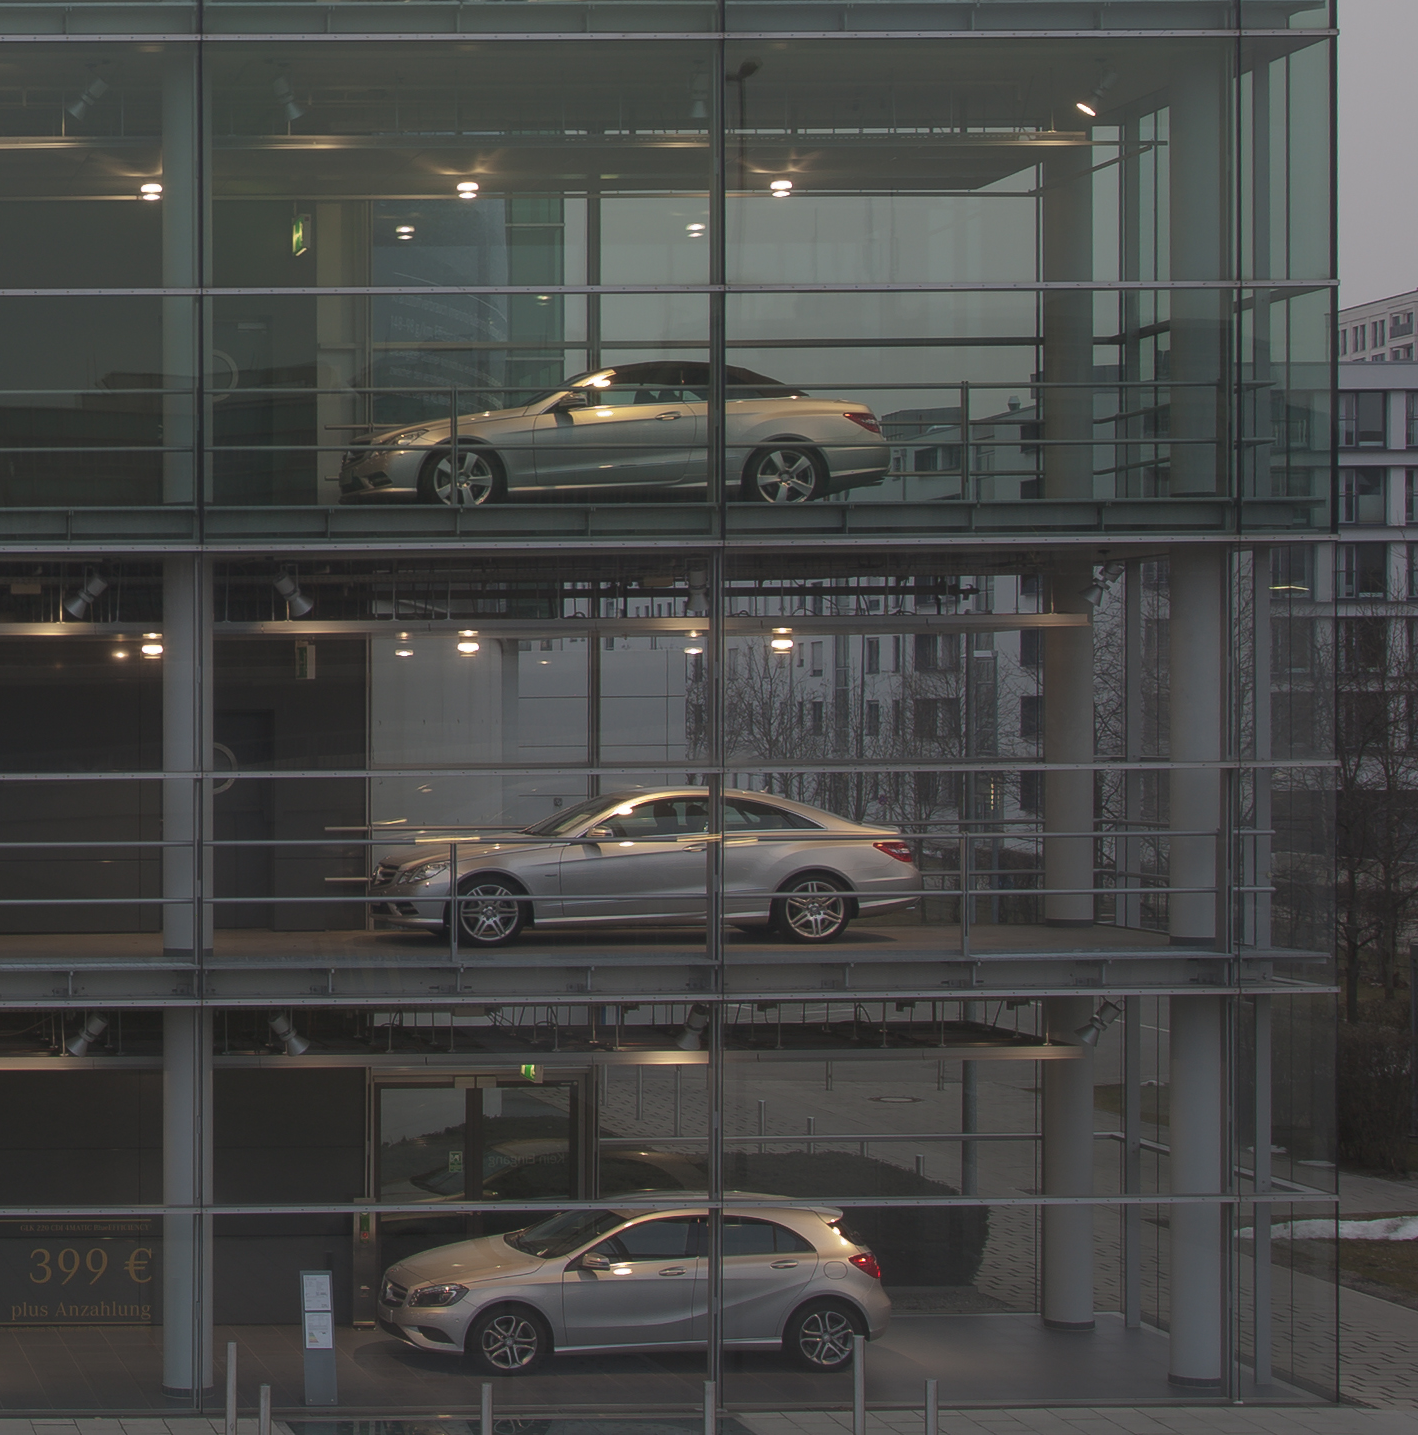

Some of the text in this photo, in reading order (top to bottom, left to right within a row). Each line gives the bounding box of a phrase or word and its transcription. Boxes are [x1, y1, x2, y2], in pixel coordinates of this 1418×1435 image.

[29, 1247, 153, 1286] 399 €
[11, 1301, 151, 1321] plus Anzahlung
